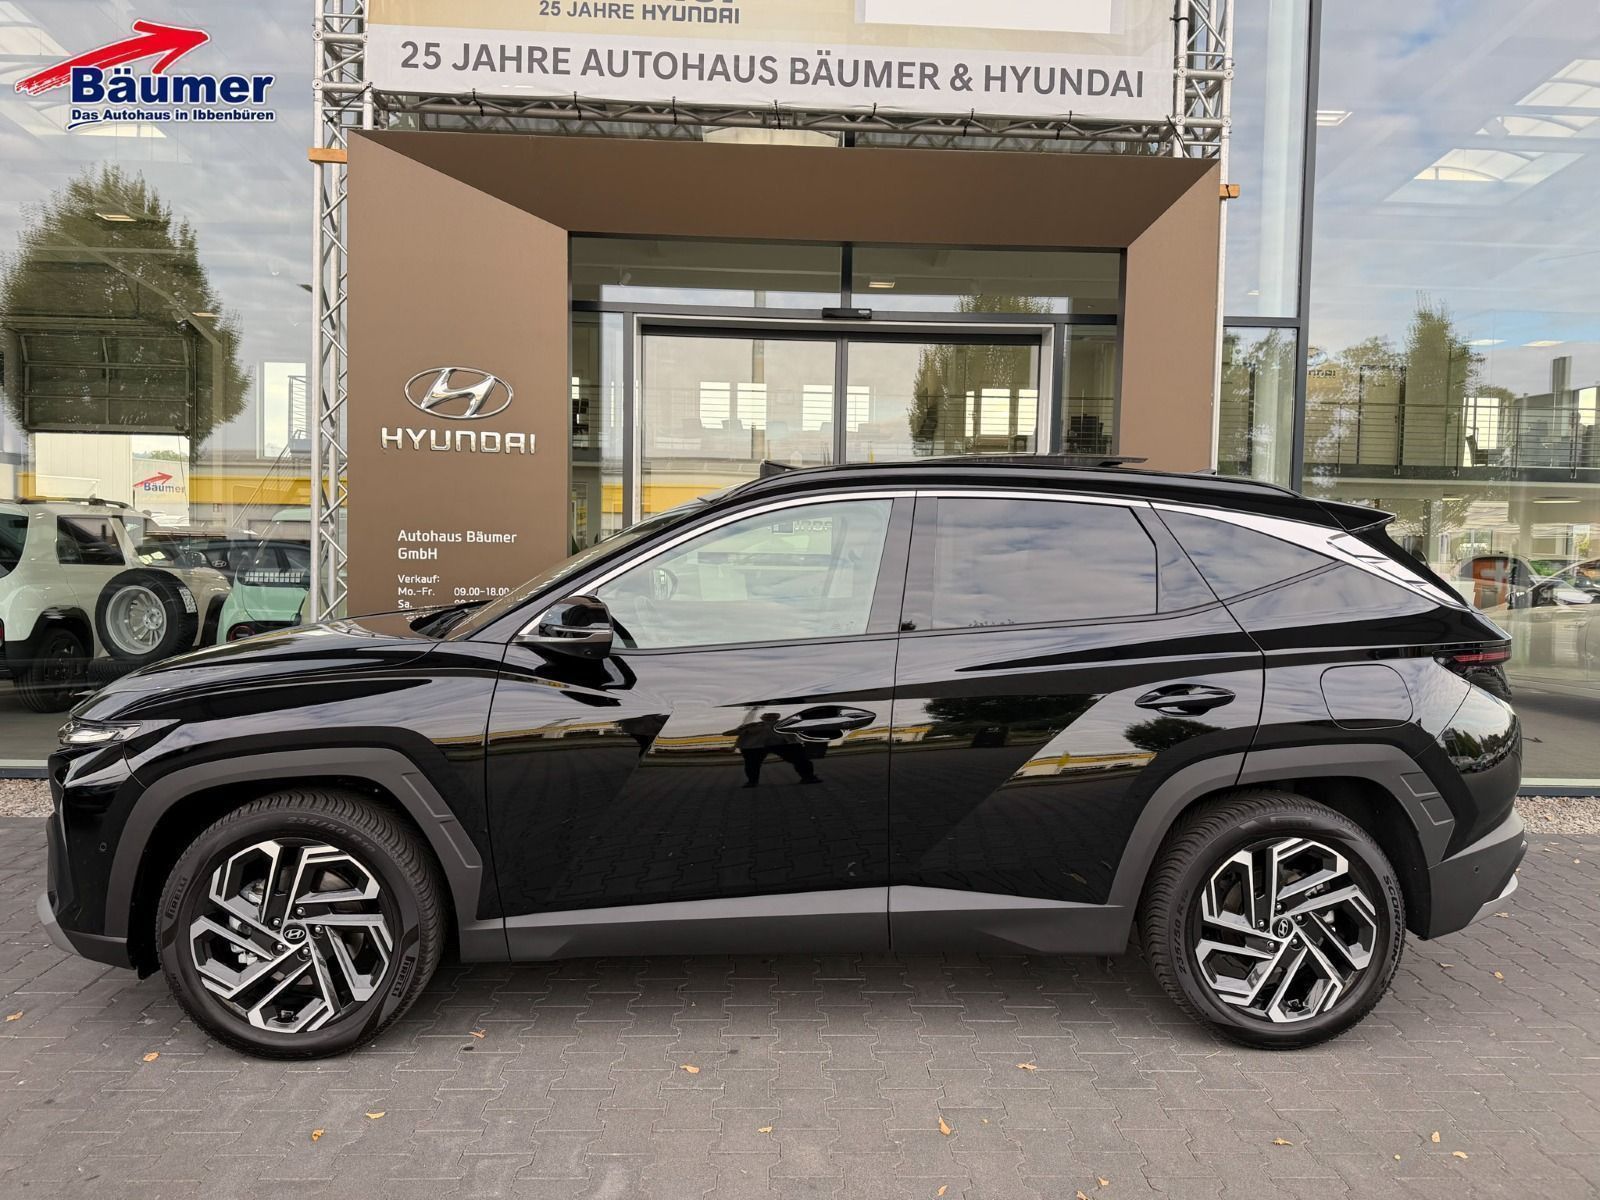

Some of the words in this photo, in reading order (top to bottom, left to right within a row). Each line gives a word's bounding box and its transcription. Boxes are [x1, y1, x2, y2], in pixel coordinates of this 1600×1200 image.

[539, 1, 561, 17] 25
[567, 1, 635, 20] JAHRE
[642, 4, 740, 25] HYUNDAI
[401, 41, 442, 70] 25
[451, 43, 571, 75] JAHRE
[580, 48, 779, 85] AUTOHAUS
[790, 49, 939, 91] BÄUMER
[949, 63, 974, 92] &
[984, 64, 1144, 98] HYUNDAI
[381, 427, 536, 455] HYUNDAI
[144, 482, 185, 493] Bäumer
[398, 530, 462, 544] Autohaus
[466, 530, 518, 544] Bäumer
[398, 548, 438, 561] GmbH
[398, 574, 440, 584] Verkauf:
[398, 600, 413, 609] Sa.
[1383, 874, 1402, 962] SCORPION
[392, 956, 417, 998] PIRELLI
